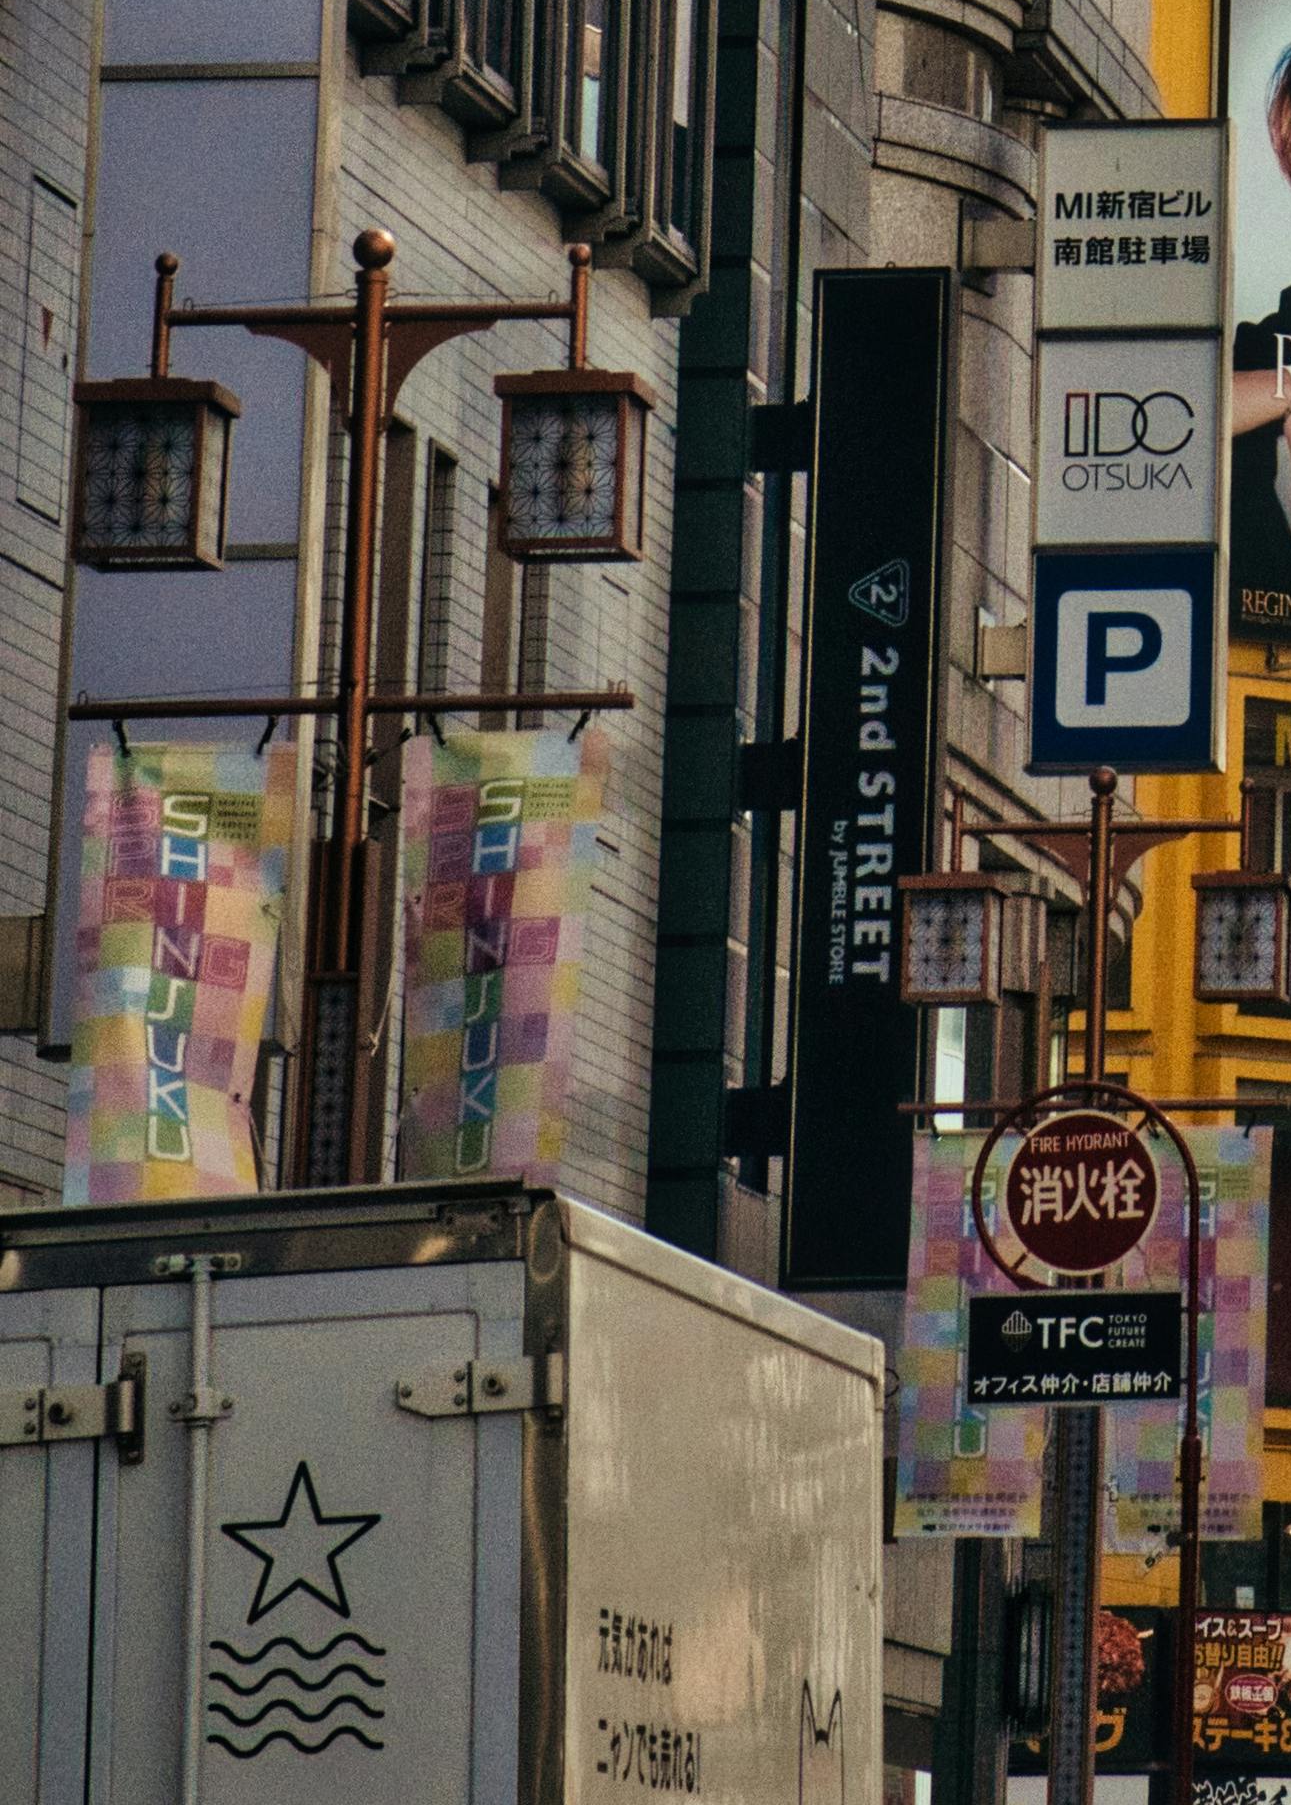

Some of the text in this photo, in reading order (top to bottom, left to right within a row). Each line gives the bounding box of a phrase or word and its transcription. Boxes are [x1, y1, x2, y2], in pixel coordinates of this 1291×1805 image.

[1054, 191, 1212, 221] MI新宿ビル
[1054, 235, 1211, 266] 南館駐車場
[1064, 392, 1194, 456] IDC
[1062, 464, 1192, 491] OTSUKA
[852, 645, 900, 984] 2nd STREET
[829, 923, 846, 985] STORE
[147, 794, 210, 1161] SHINJUKU
[457, 780, 525, 1172] SHINJUKU
[1031, 1132, 1130, 1155] FIRE HYDRANT
[1020, 1158, 1145, 1226] 消火栓
[1037, 1316, 1104, 1349] TFC
[1108, 1326, 1146, 1336] FUTURE
[1109, 1314, 1147, 1324] TOKYO
[1108, 1338, 1146, 1349] CREATE
[973, 1372, 1172, 1396] オフィス仲介・店舗仲介
[1195, 1618, 1283, 1640] イス&スープ
[598, 1608, 673, 1686] 元気があれば
